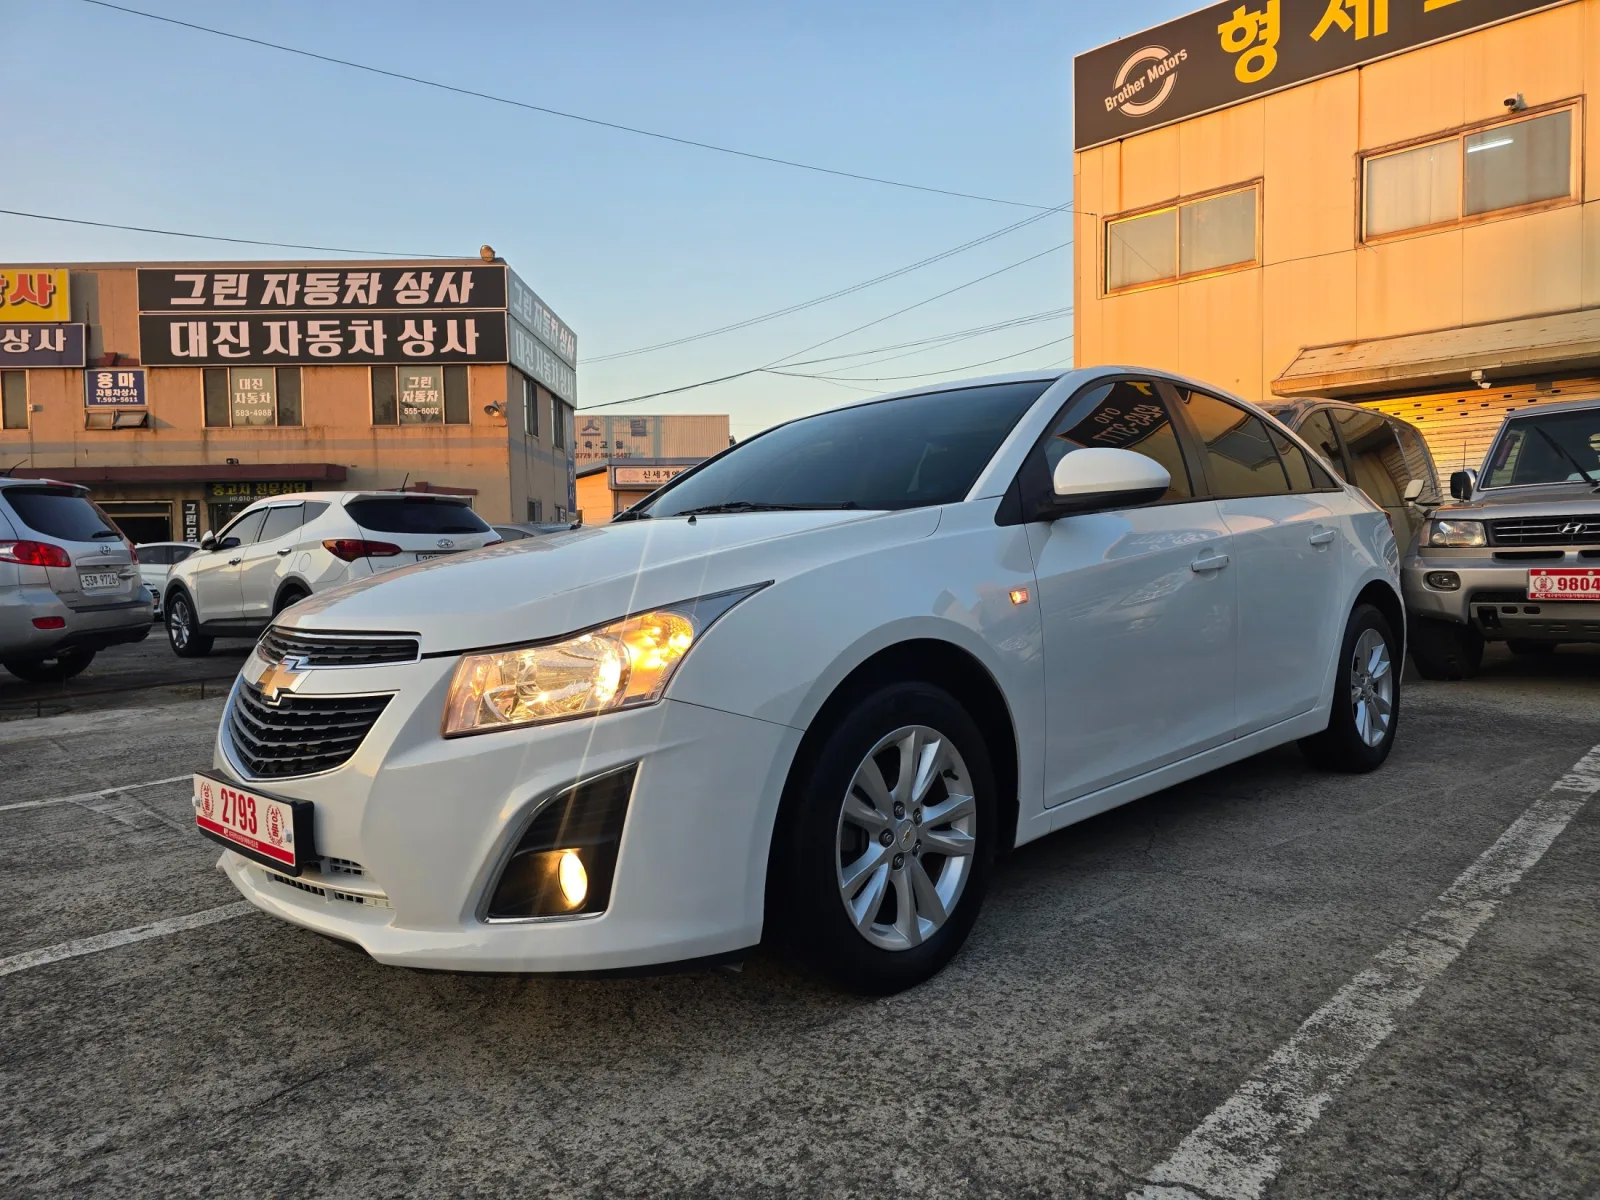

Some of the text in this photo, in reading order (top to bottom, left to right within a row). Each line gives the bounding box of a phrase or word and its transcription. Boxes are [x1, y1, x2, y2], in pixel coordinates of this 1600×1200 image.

[1104, 48, 1188, 112] Brother Motors
[0, 273, 54, 307] 사
[170, 270, 475, 306] 그린 자동차 상사
[513, 280, 575, 361] 그린 자동차 상사
[0, 328, 67, 353] 상사
[170, 318, 480, 358] 대진 자동차 상사
[515, 328, 534, 370] 대진
[534, 346, 559, 389] 자동차
[239, 378, 264, 390] 대진
[408, 376, 432, 389] 그린
[234, 392, 271, 405] 자동차
[402, 390, 439, 403] 자동차
[404, 407, 439, 415] 555-6002
[185, 503, 197, 526] 그린
[1557, 577, 1600, 591] 9804
[220, 787, 258, 835] 2793
